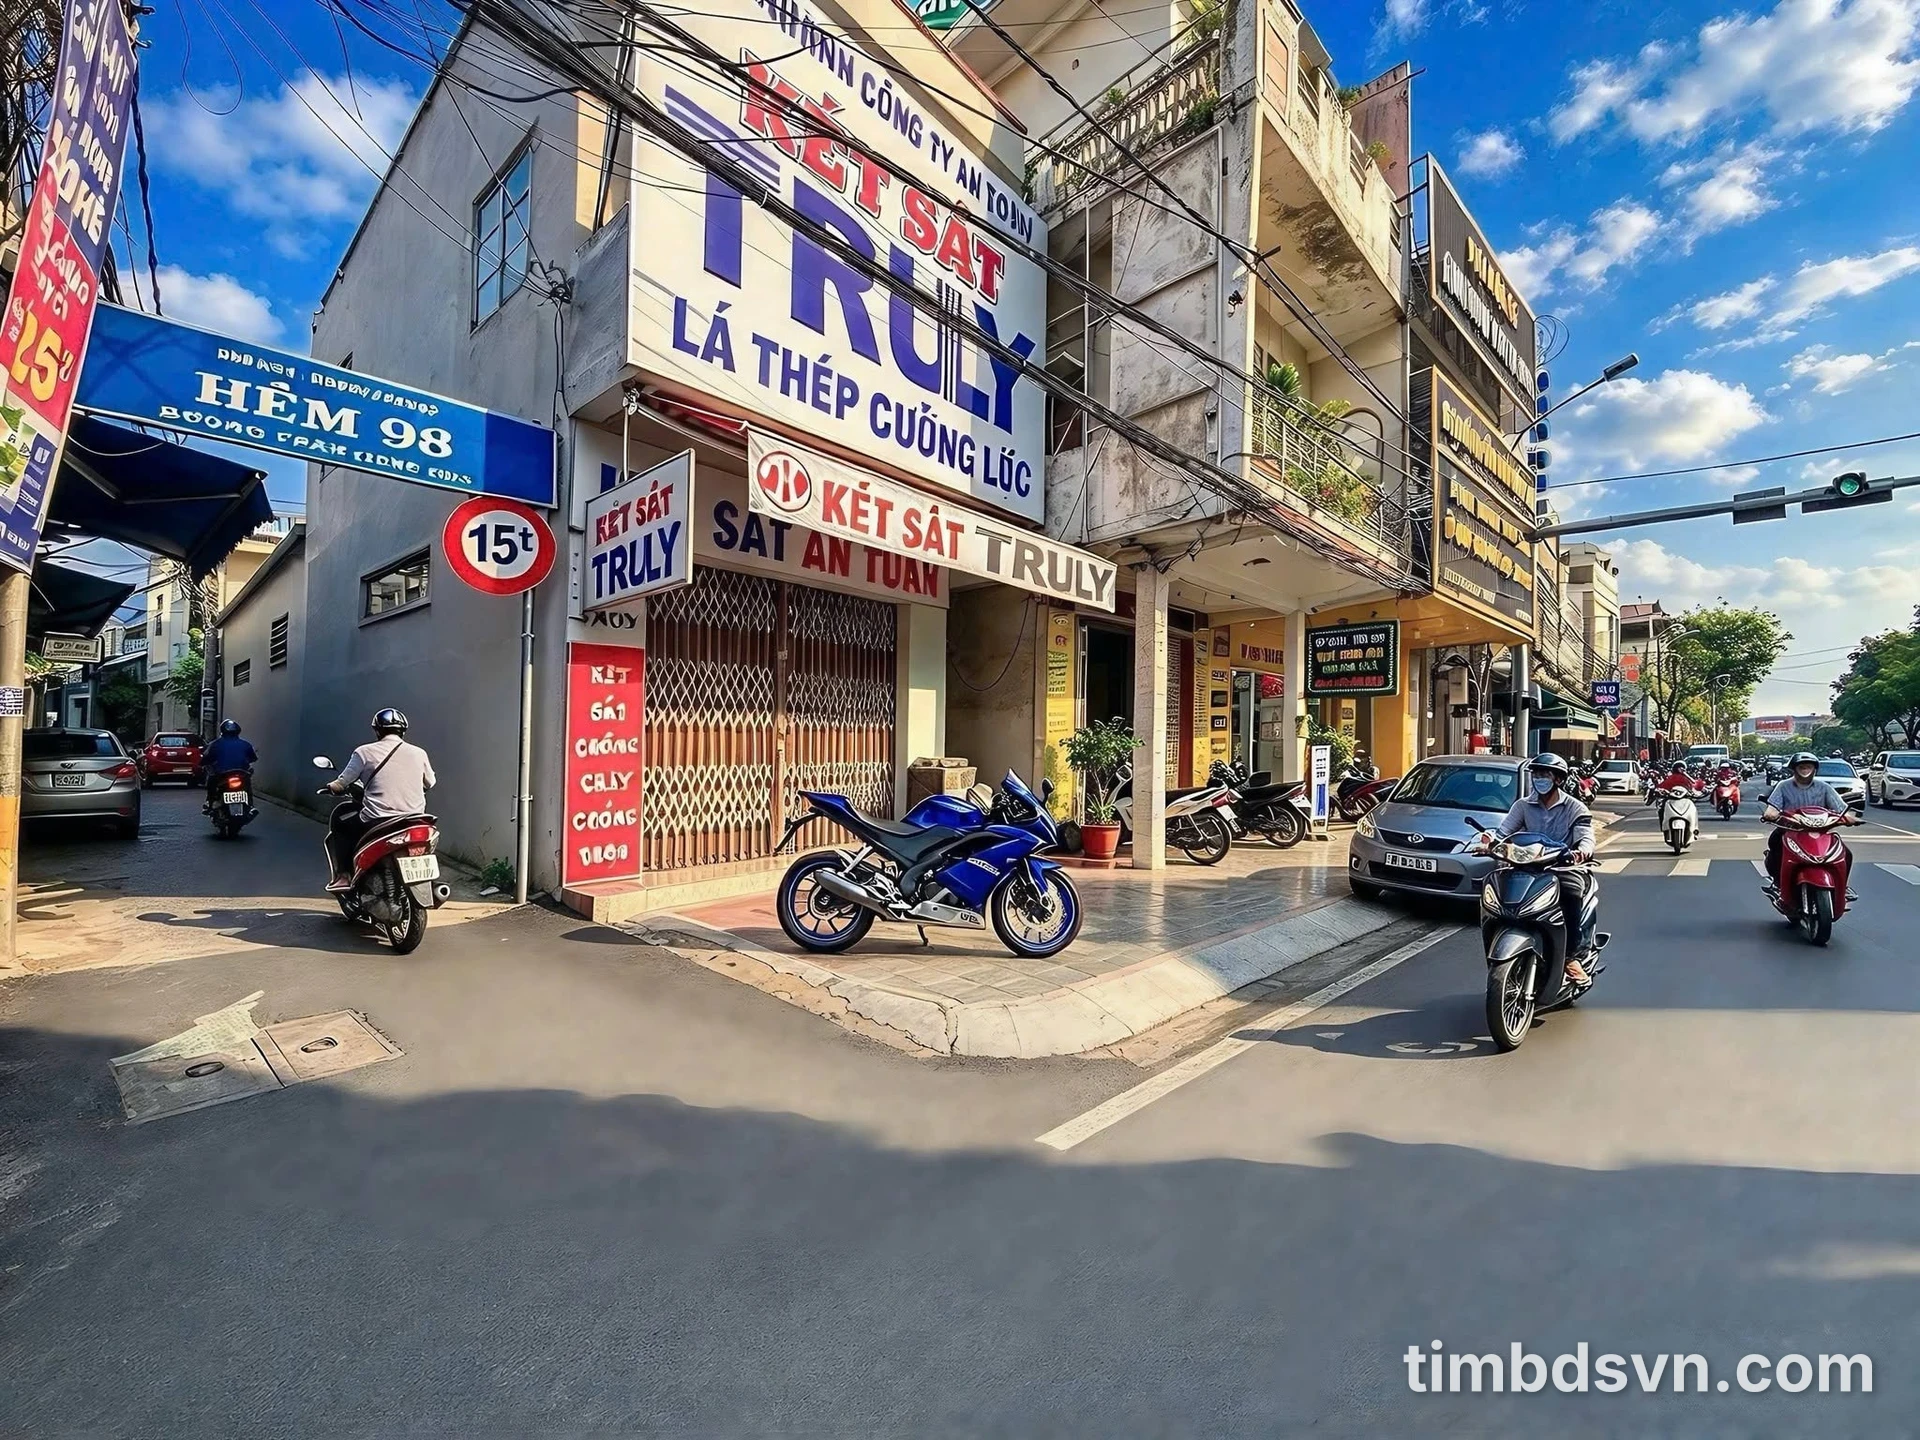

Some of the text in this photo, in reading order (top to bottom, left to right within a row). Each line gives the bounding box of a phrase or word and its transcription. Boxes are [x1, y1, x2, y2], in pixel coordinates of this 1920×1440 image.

[930, 131, 954, 172] TY
[956, 158, 982, 201] AN
[665, 84, 1037, 436] TRULY
[673, 296, 736, 373] LÁ
[752, 332, 860, 421] THÉP
[379, 416, 453, 459] 98
[466, 523, 535, 566] 15t
[591, 520, 682, 600] TRULY
[975, 525, 1114, 602] TRULY
